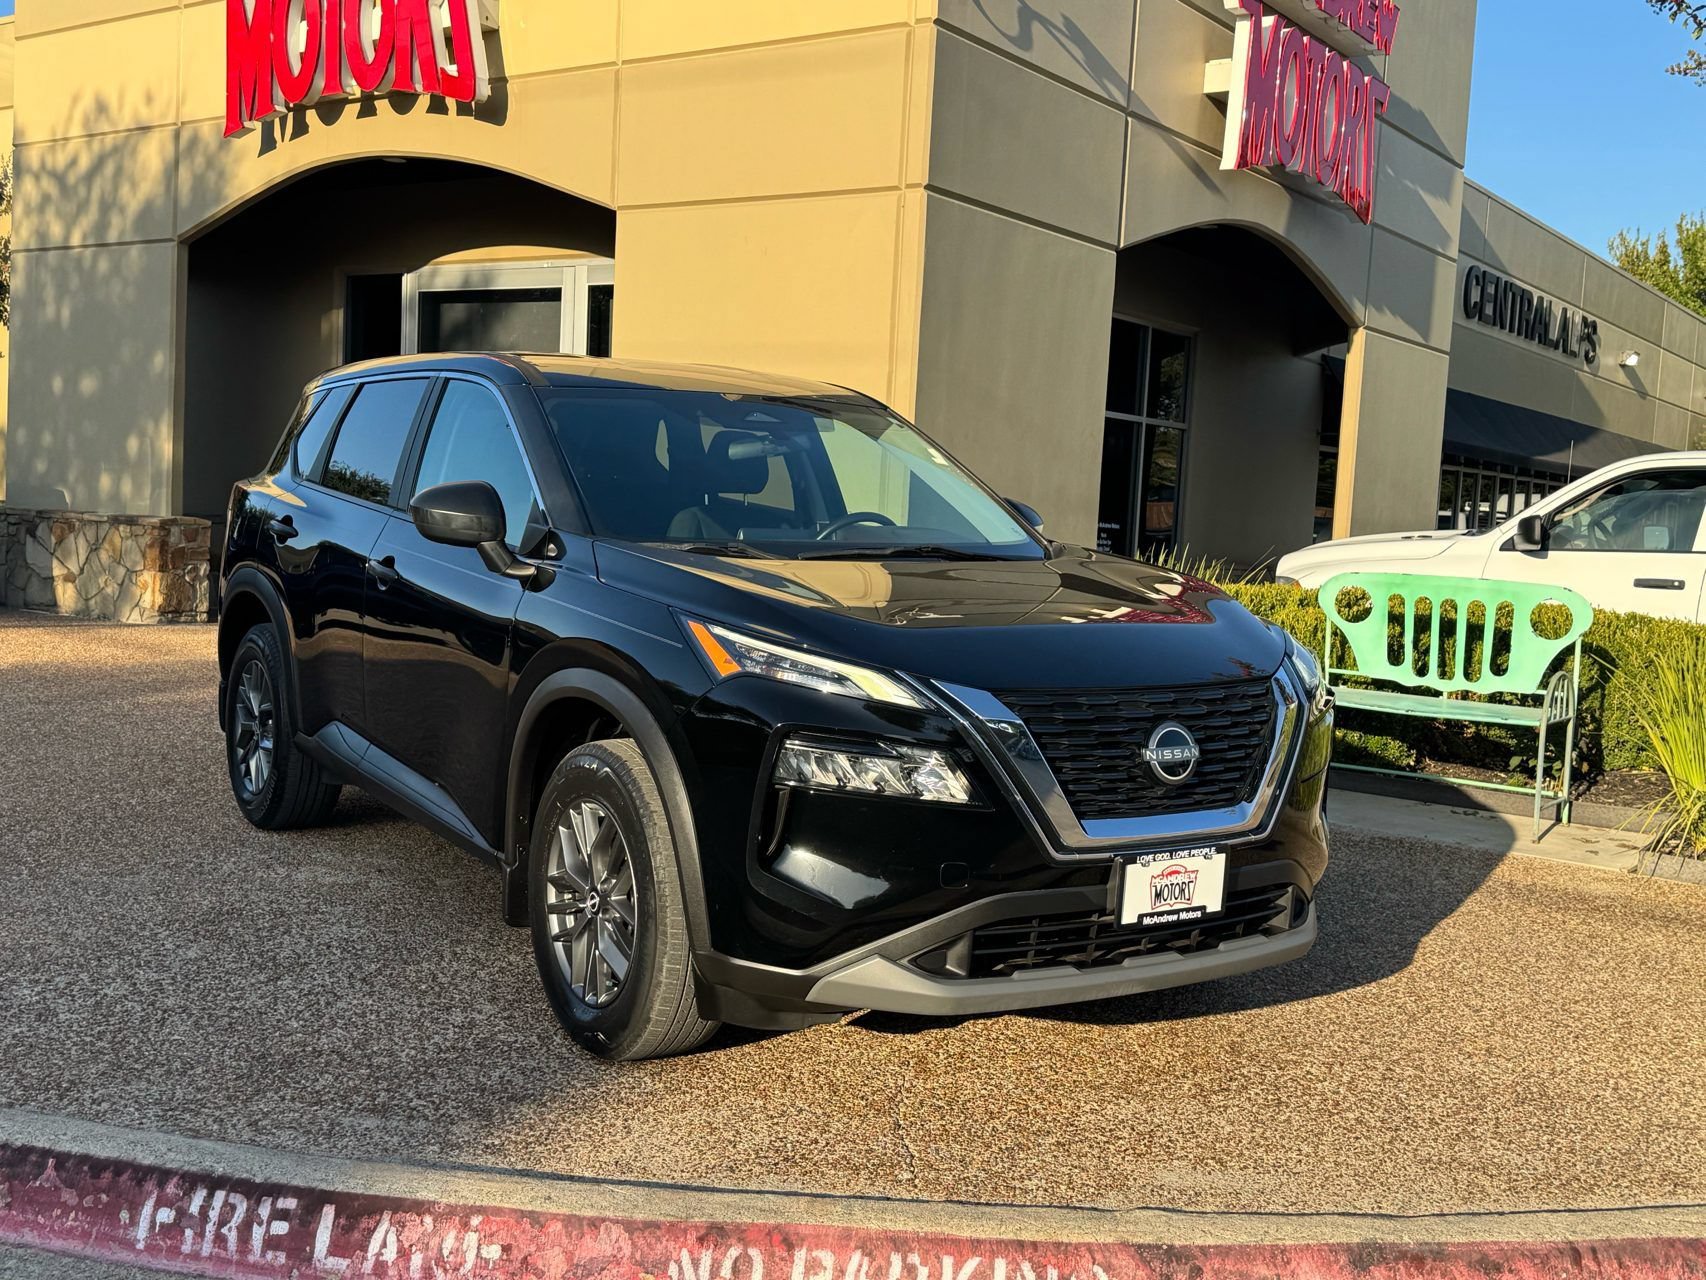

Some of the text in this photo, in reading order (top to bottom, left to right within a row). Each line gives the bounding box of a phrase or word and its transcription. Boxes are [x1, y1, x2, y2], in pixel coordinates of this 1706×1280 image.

[1146, 747, 1199, 760] NISSAN
[1137, 854, 1155, 864] LOVE
[1173, 850, 1190, 859] LOVE
[1152, 880, 1194, 906] MOTORS
[1142, 910, 1202, 925] McAndrew Motors
